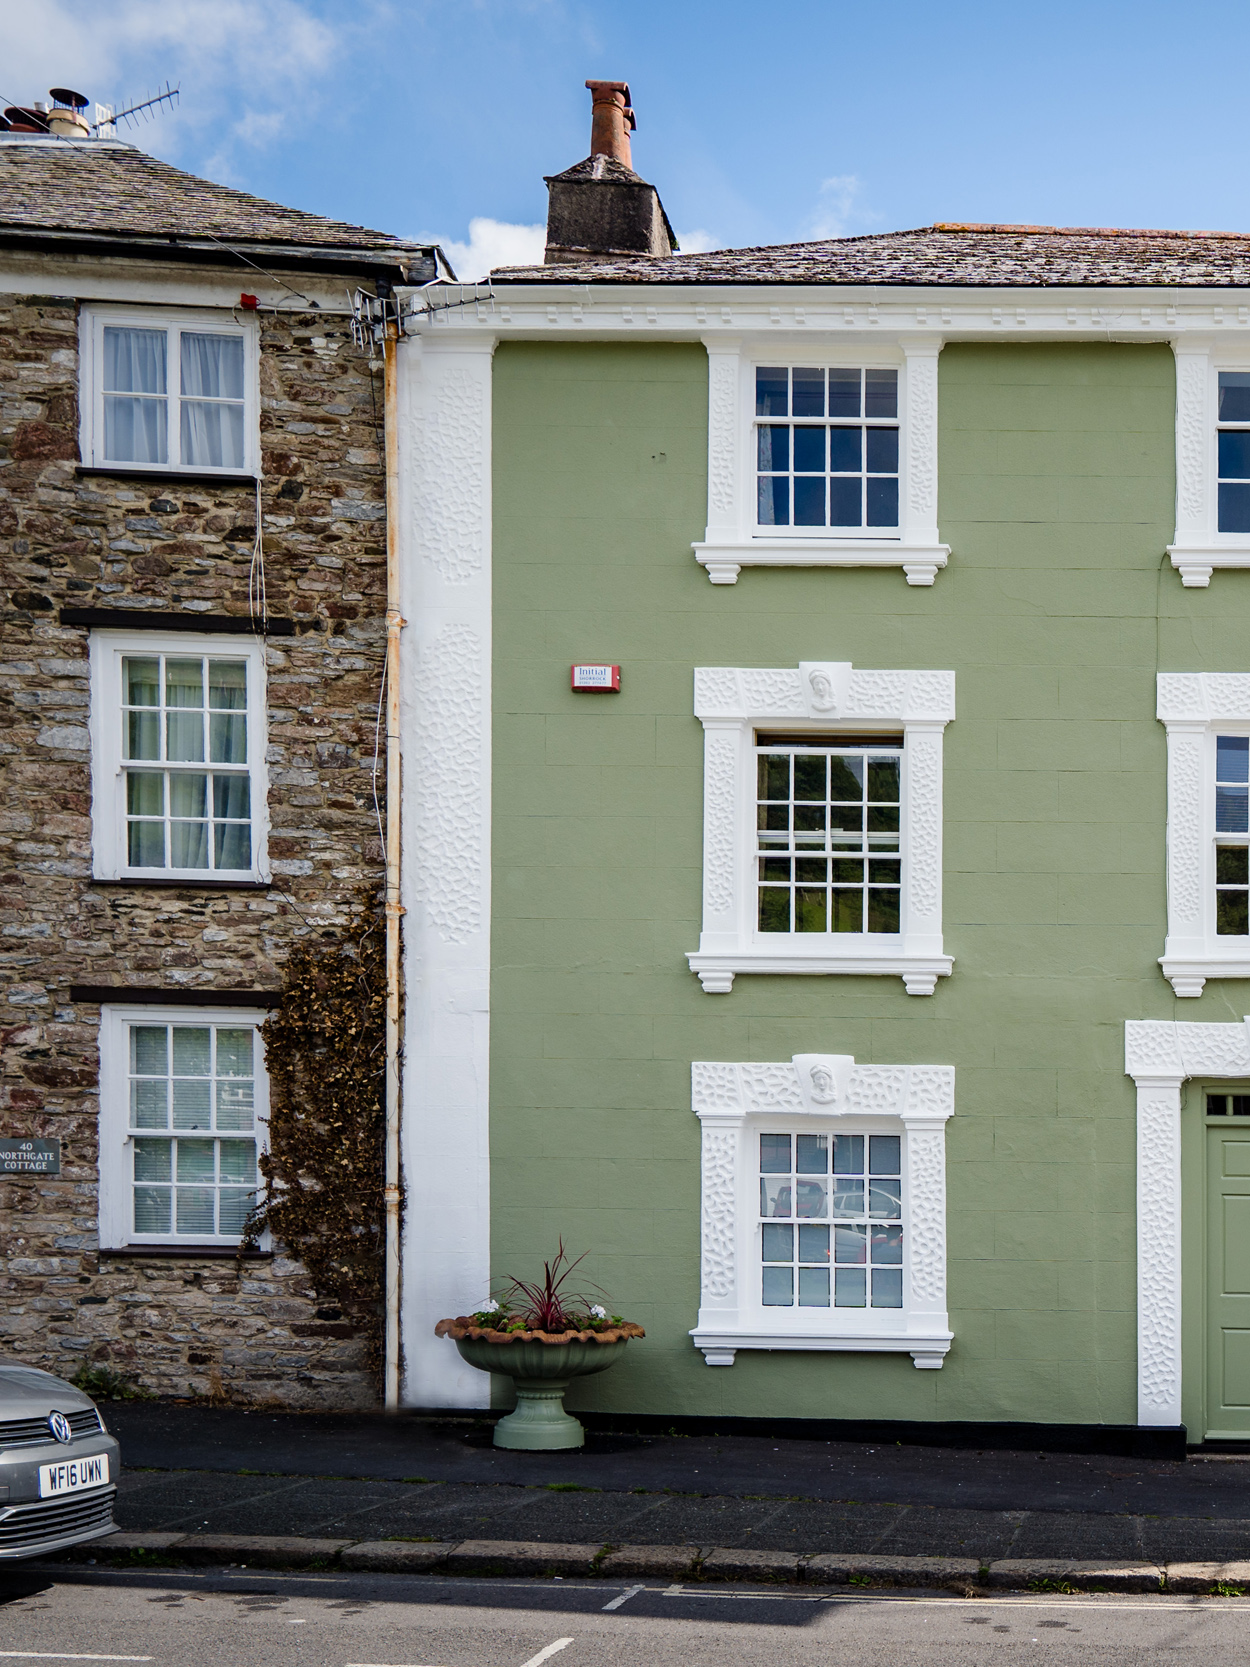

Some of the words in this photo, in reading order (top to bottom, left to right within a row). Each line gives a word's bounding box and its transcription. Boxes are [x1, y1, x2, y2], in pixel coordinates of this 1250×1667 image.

[579, 667, 607, 676] Initial
[19, 1142, 34, 1151] 40
[0, 1151, 55, 1161] NORTHGATE
[4, 1161, 48, 1170] COTTAGE
[48, 1463, 78, 1490] WF16
[80, 1458, 102, 1484] UWN
